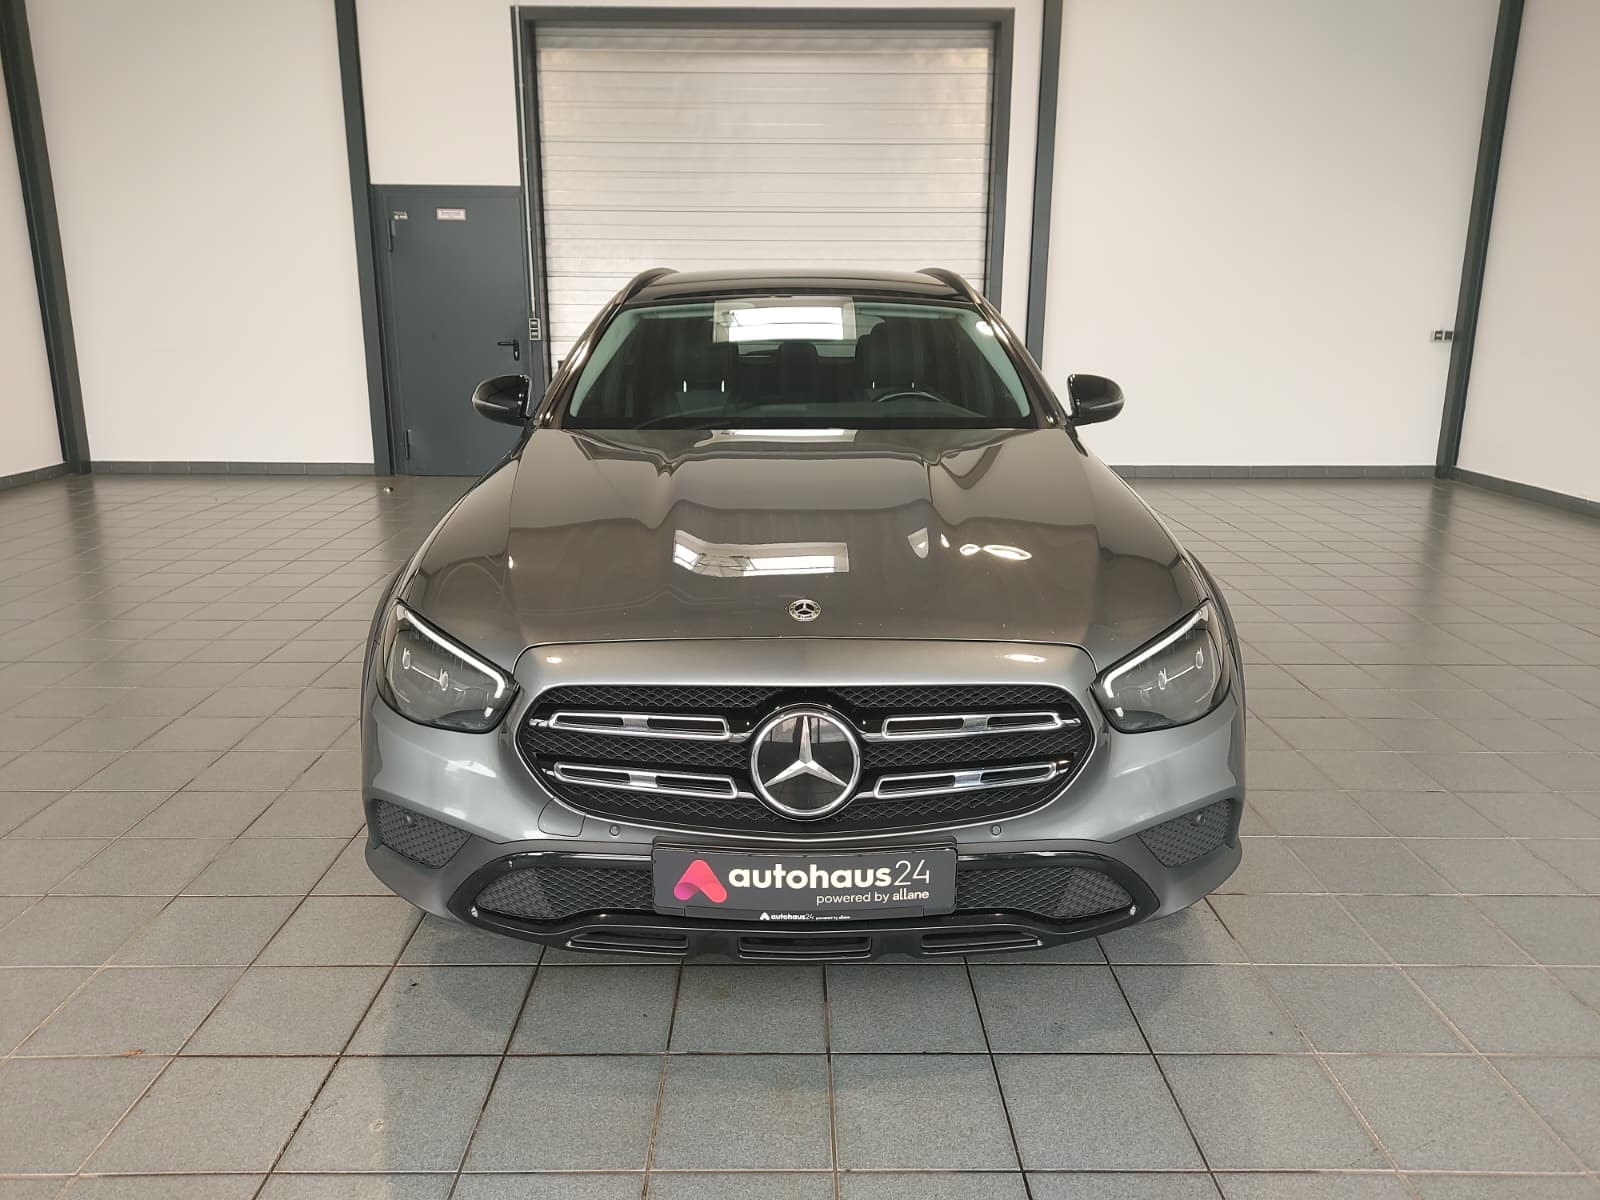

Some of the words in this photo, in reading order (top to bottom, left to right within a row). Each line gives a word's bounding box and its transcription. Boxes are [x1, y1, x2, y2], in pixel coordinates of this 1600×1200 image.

[728, 859, 930, 889] autohaus24
[816, 892, 871, 906] powered
[874, 891, 890, 904] by
[892, 888, 930, 901] allane
